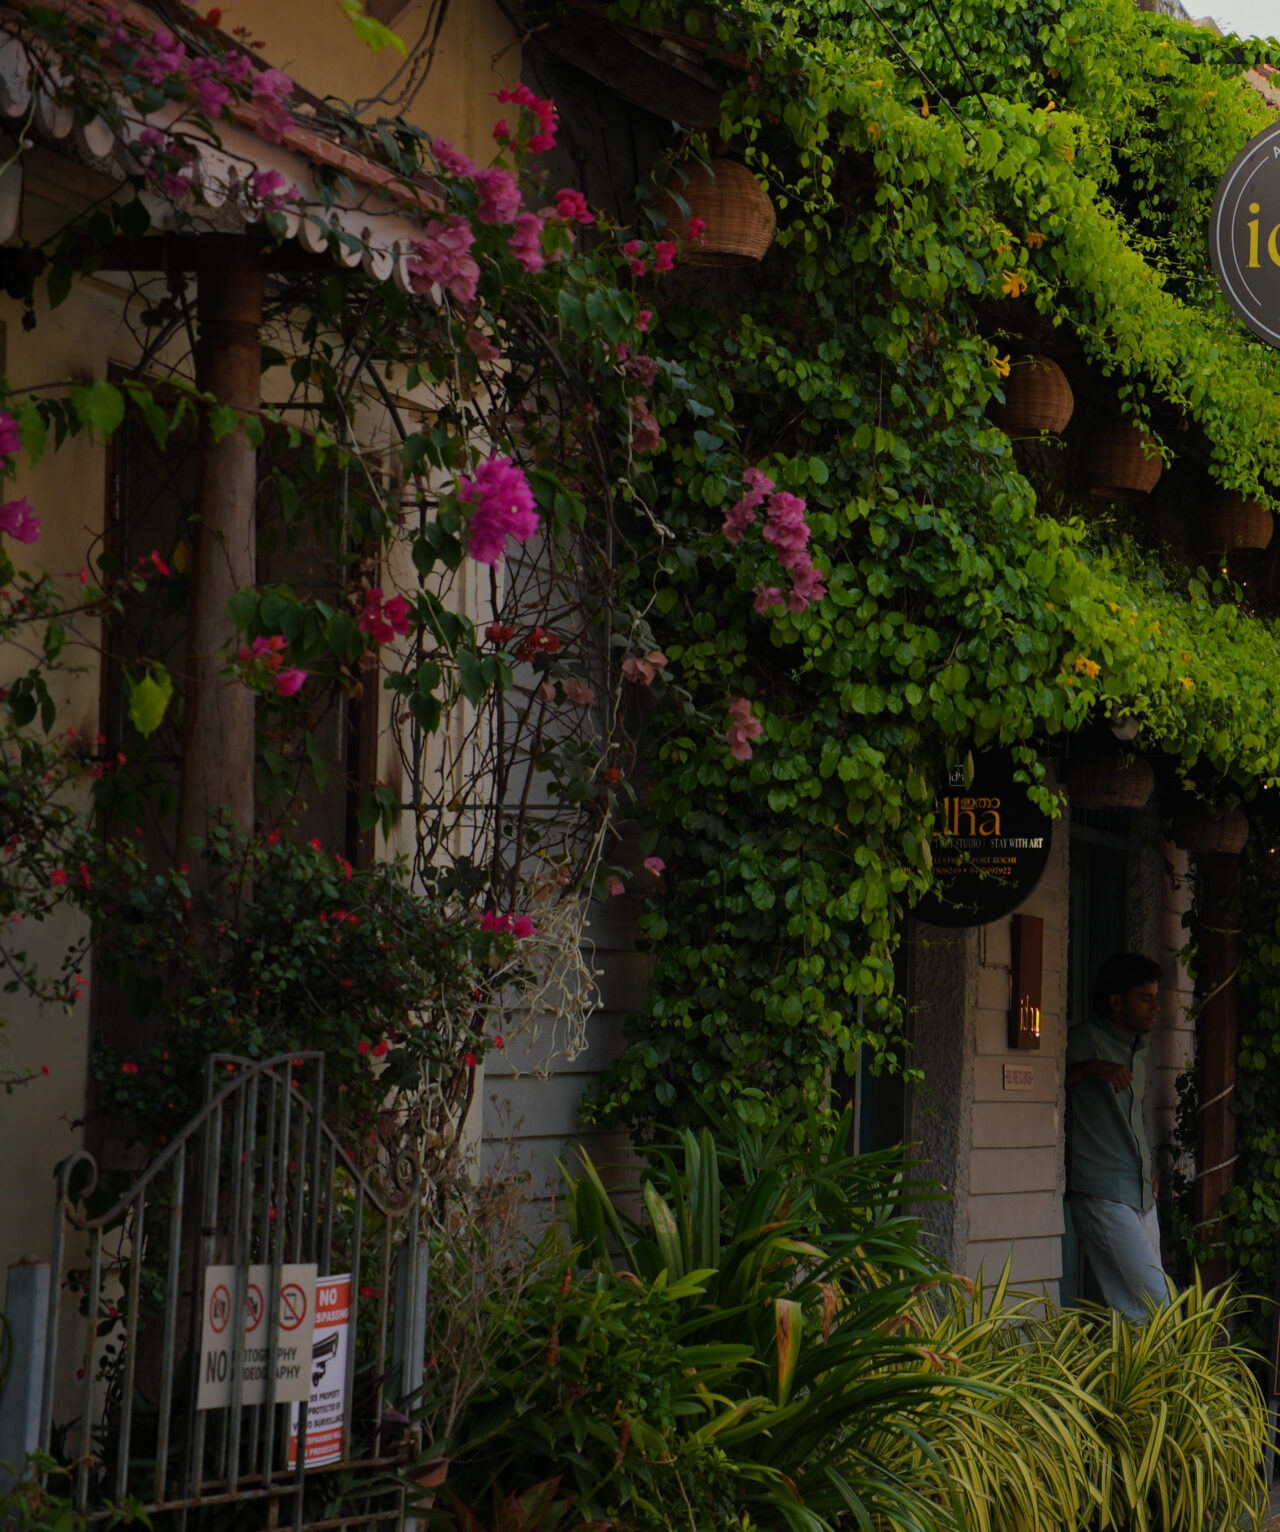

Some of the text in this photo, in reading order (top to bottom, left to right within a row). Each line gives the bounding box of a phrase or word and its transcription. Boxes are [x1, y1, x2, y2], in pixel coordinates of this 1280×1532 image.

[932, 796, 1002, 837] dha
[955, 838, 982, 848] STUDIO
[990, 838, 1007, 848] STAY
[1008, 838, 1029, 848] WITH
[1028, 838, 1044, 848] ART
[993, 856, 1017, 864] KOCHI
[319, 1288, 337, 1307] NO
[205, 1351, 227, 1384] NO
